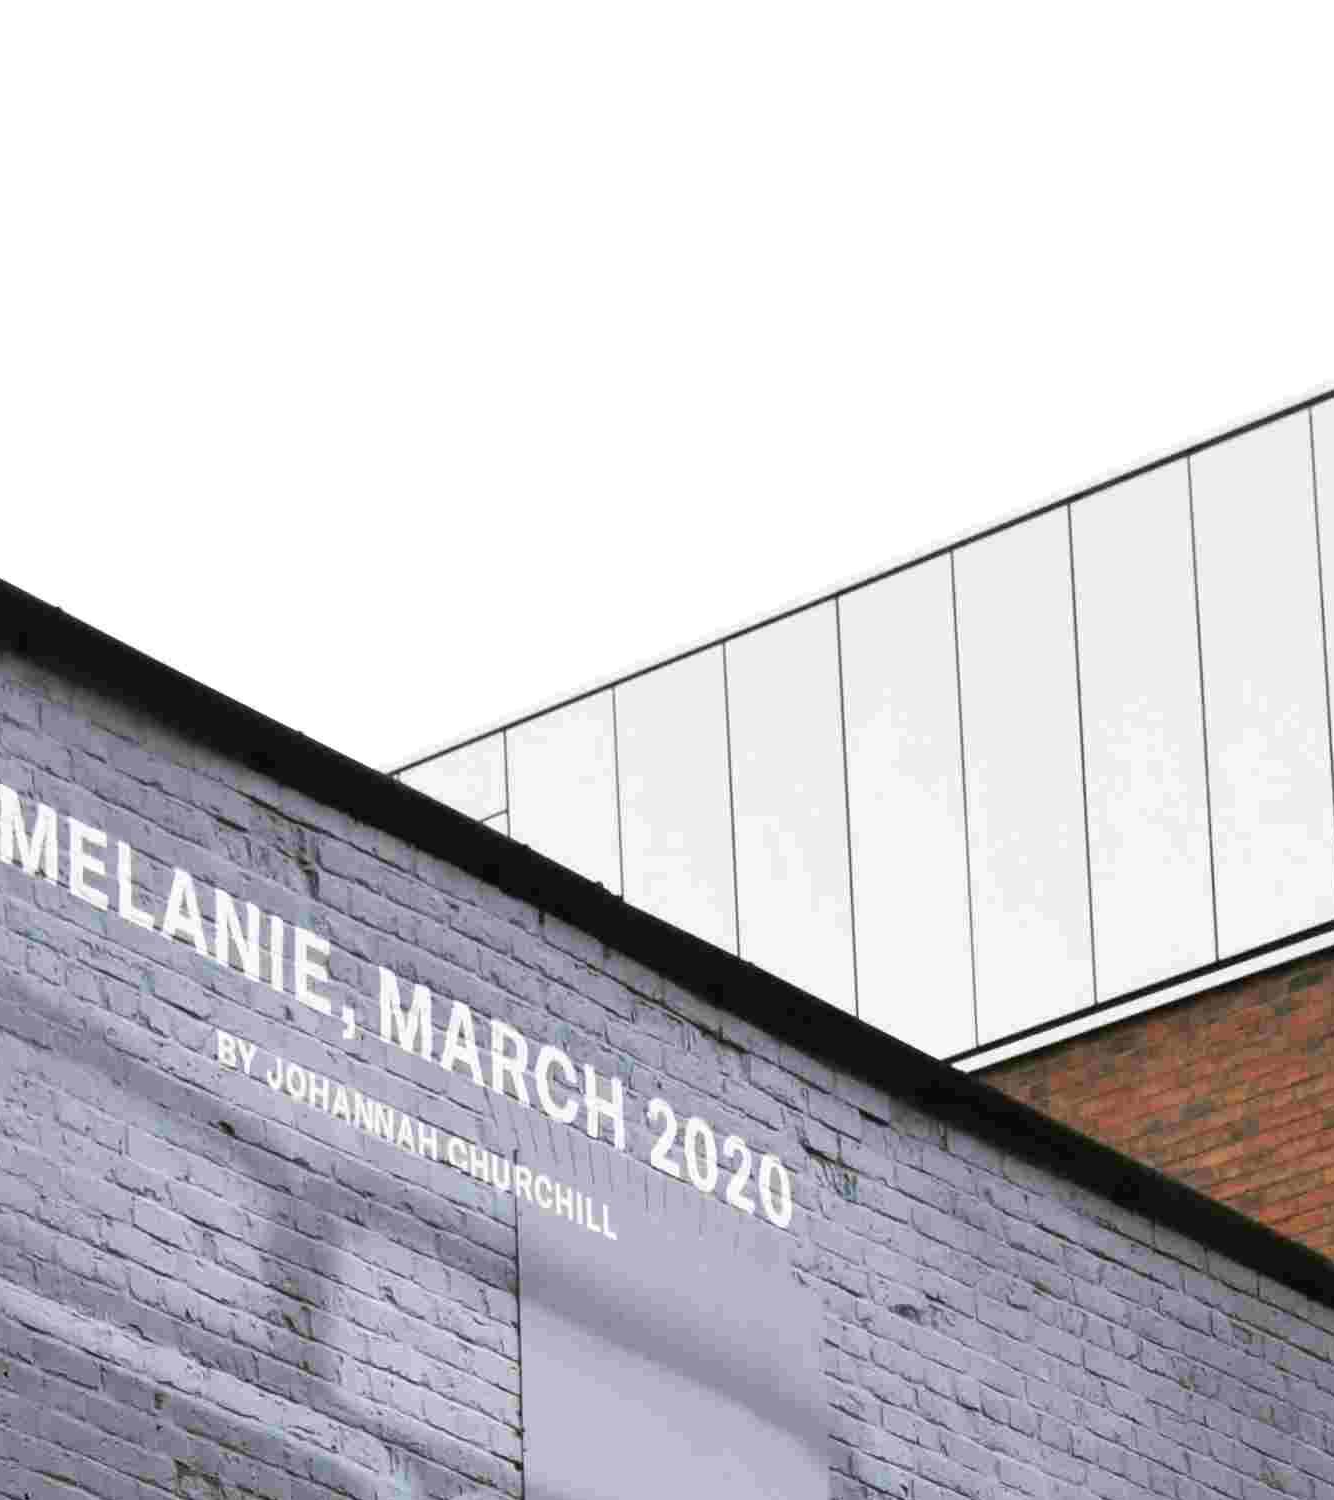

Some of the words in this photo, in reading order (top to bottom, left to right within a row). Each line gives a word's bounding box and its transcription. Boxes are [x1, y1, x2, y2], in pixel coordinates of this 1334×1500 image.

[217, 1029, 258, 1075] BY
[267, 1057, 439, 1161] JOHANNAH
[446, 1136, 618, 1240] CHURCHILL
[378, 965, 627, 1152] MARCH
[647, 1096, 795, 1230] 2020
